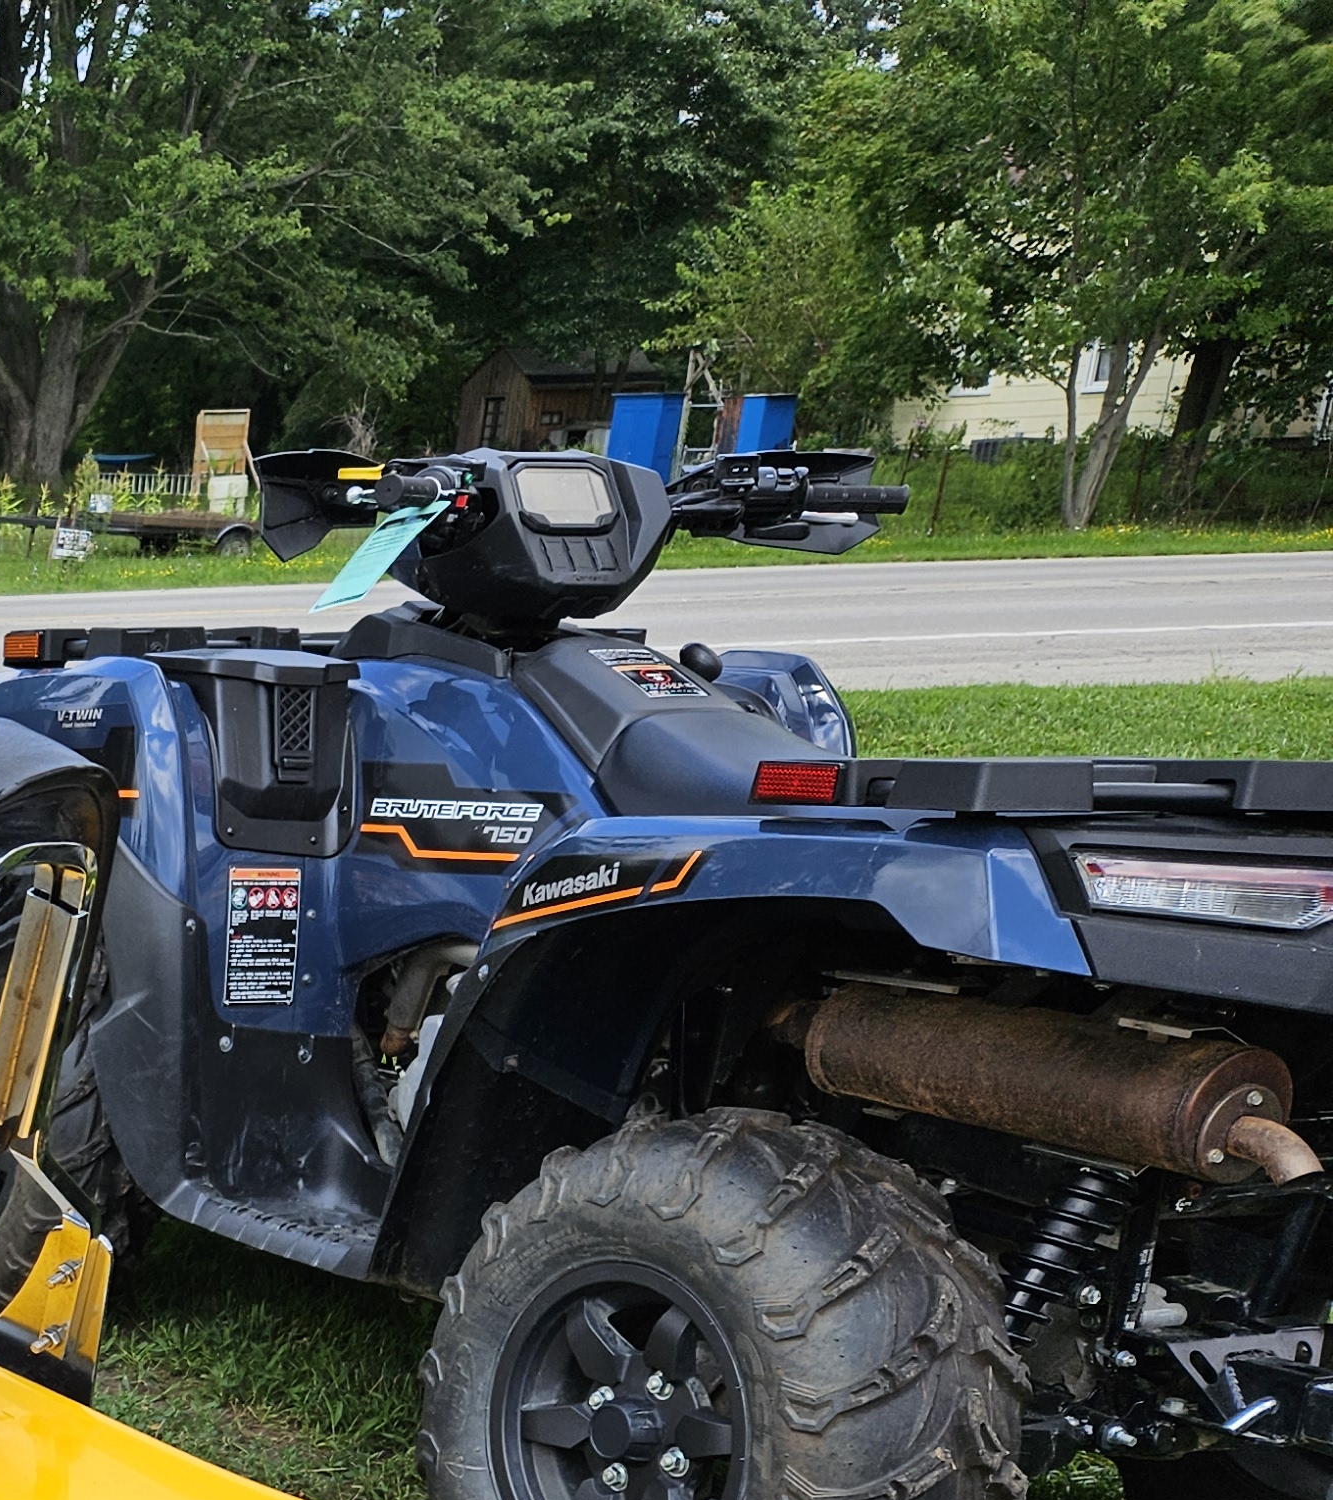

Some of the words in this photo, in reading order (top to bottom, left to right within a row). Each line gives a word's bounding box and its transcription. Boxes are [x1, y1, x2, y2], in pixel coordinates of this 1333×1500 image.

[57, 708, 103, 722] V-TWIN
[483, 826, 533, 844] 750
[521, 861, 621, 908] Kawasaki
